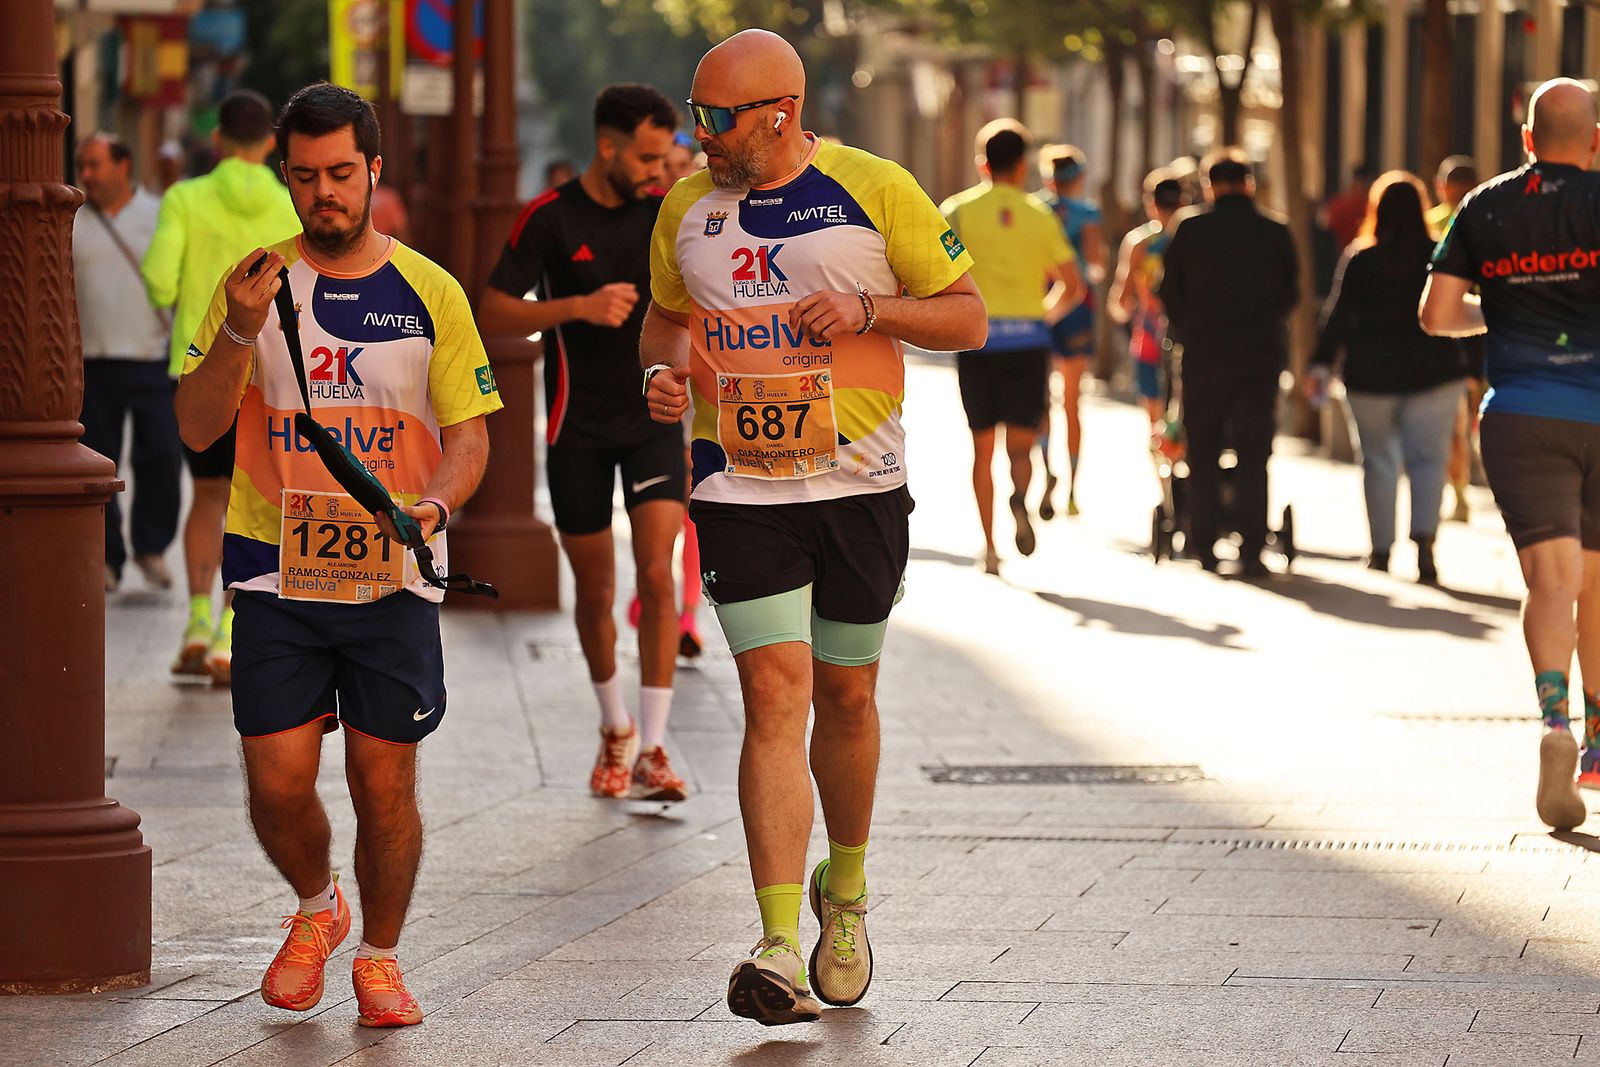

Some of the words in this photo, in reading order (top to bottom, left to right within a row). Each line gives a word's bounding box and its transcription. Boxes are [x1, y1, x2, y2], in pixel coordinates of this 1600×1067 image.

[786, 205, 847, 223] AVATEL
[731, 243, 788, 283] 21K
[733, 282, 790, 298] HUELVA
[363, 312, 423, 329] AVATEL
[310, 346, 365, 386] 21K
[782, 352, 833, 368] original
[800, 374, 823, 391] 21K
[310, 385, 365, 400] HUELVA
[800, 390, 824, 399] HUELVA
[736, 403, 810, 441] 687
[738, 449, 759, 458] DIAZ
[761, 447, 815, 459] MONTERO
[362, 457, 394, 472] rigina
[291, 493, 313, 512] 21K
[292, 522, 391, 562] 1281
[288, 567, 328, 578] RAMOS
[331, 569, 391, 581] GONZALEZ
[285, 576, 336, 592] Huelva
